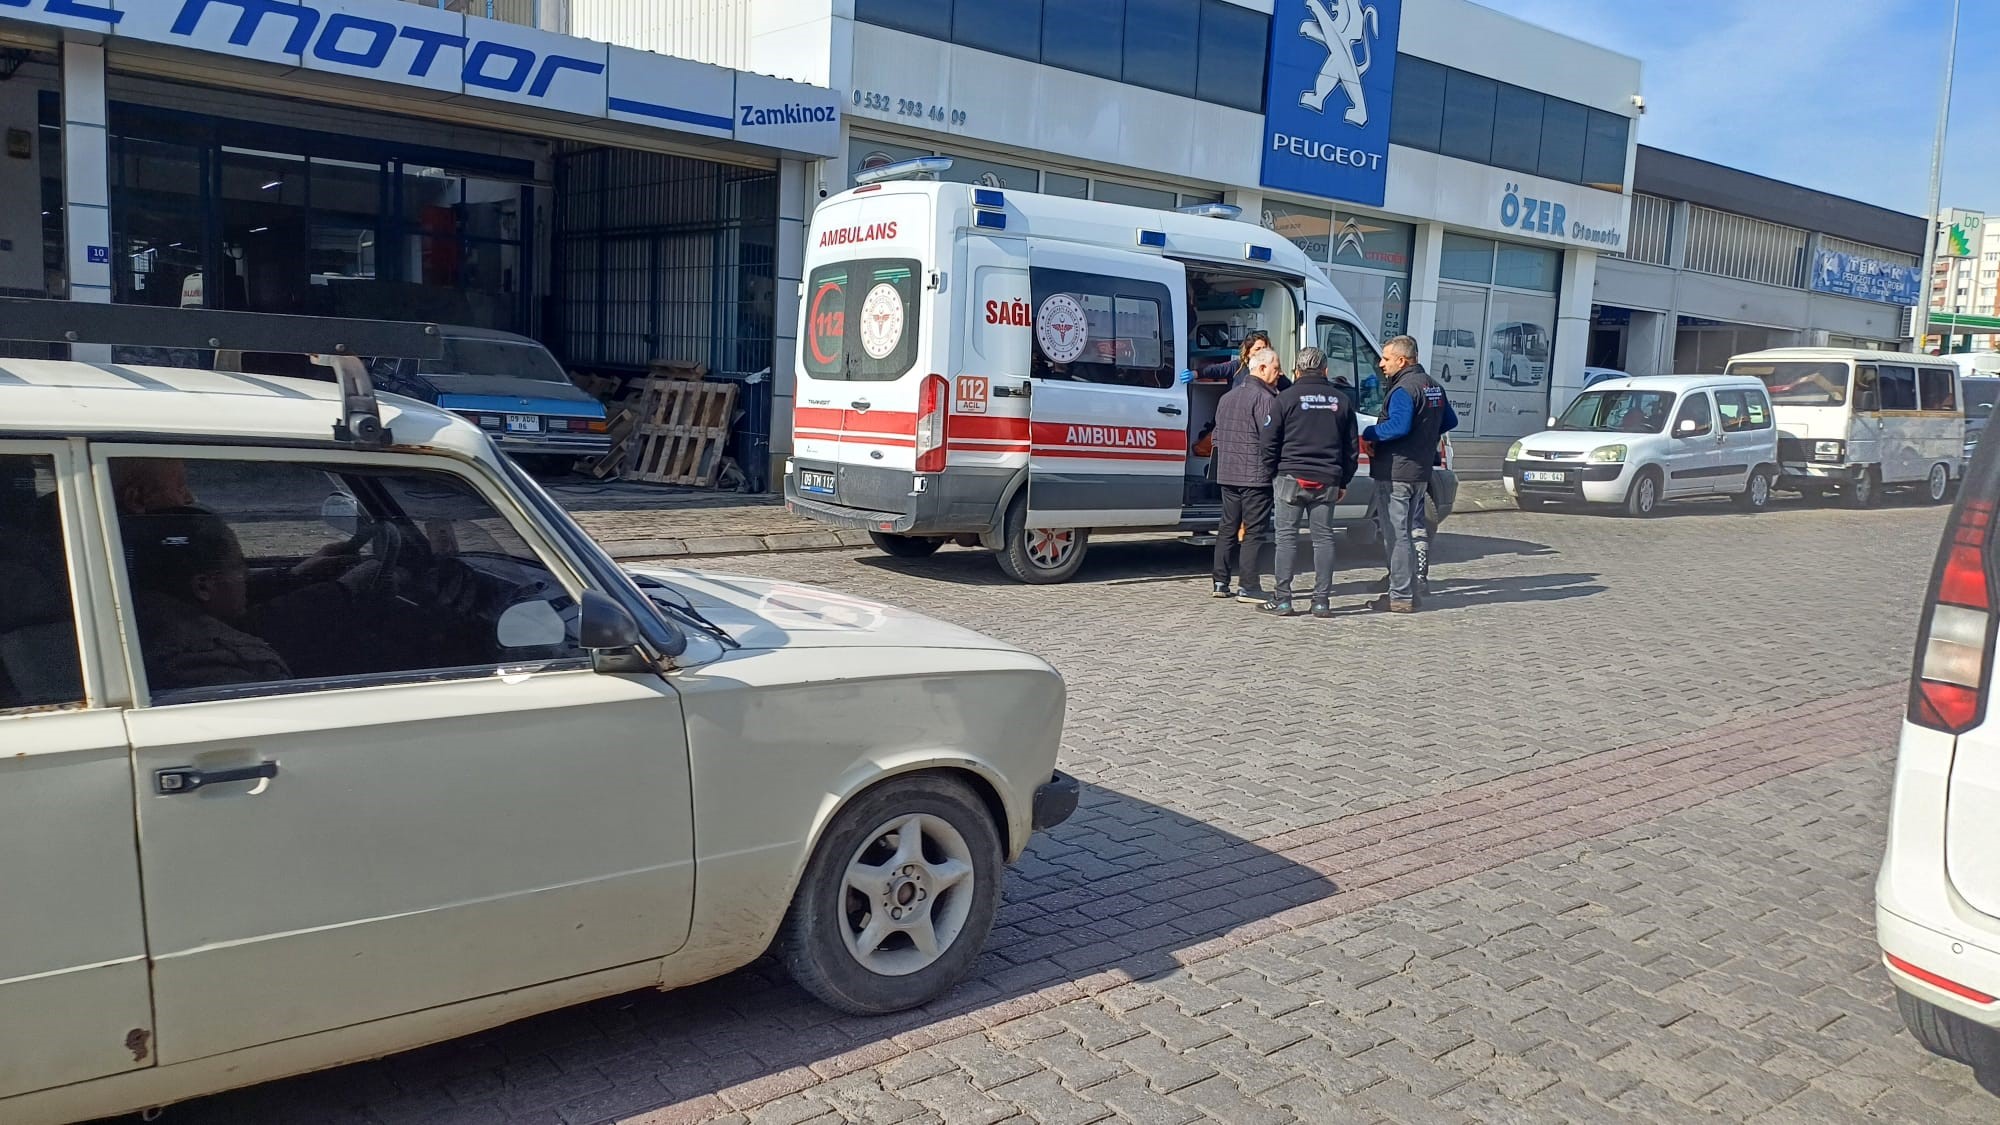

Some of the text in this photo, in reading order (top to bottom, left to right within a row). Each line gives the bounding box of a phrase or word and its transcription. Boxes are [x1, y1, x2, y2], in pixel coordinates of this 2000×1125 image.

[740, 103, 836, 126] Zamkinoz
[852, 89, 967, 127] 0 532 293 46 09
[1273, 132, 1382, 171] PEUGEOT
[1501, 182, 1566, 238] ÖZER
[1964, 212, 1980, 231] bp
[819, 221, 897, 248] AMBULANS
[93, 248, 105, 257] 10
[816, 311, 845, 337] 112
[960, 378, 985, 400] 112
[1066, 426, 1157, 448] AMBULANS
[804, 473, 811, 486] 09
[823, 475, 834, 489] 112
